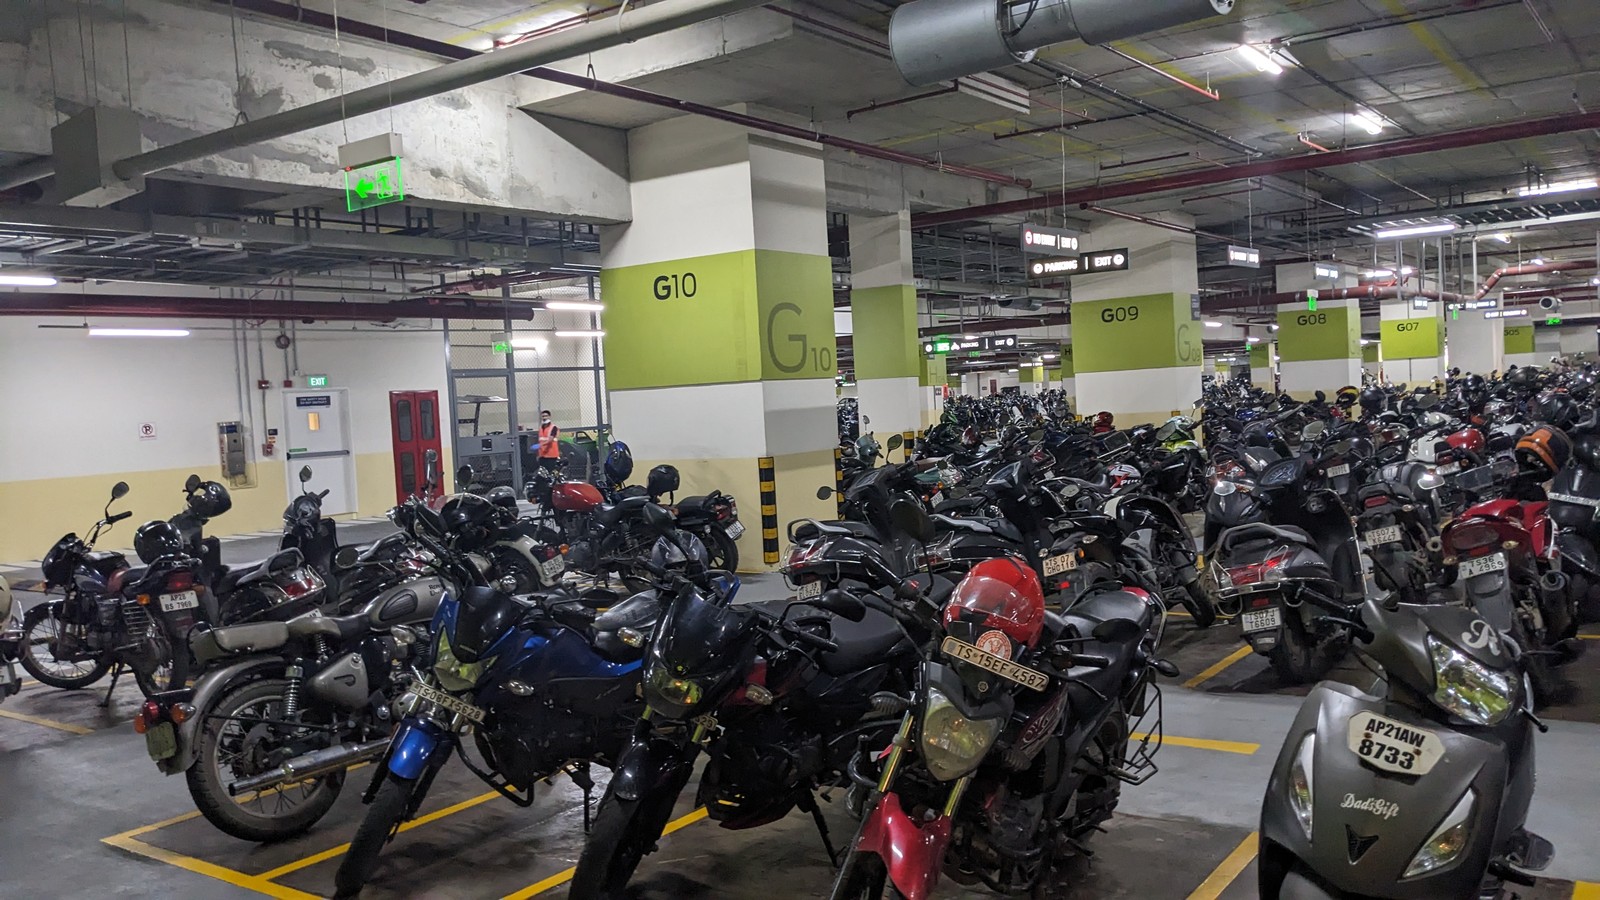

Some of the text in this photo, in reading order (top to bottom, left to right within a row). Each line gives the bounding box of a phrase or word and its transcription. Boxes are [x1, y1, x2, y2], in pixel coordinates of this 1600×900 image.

[1044, 255, 1112, 273] PARKING EXIT
[653, 272, 697, 301] G10
[1101, 305, 1139, 323] G09
[1297, 313, 1327, 326] G08
[1396, 321, 1420, 332] G07
[310, 377, 326, 386] EXIT
[1365, 718, 1425, 748] AP21AW
[1358, 739, 1416, 770] 8733
